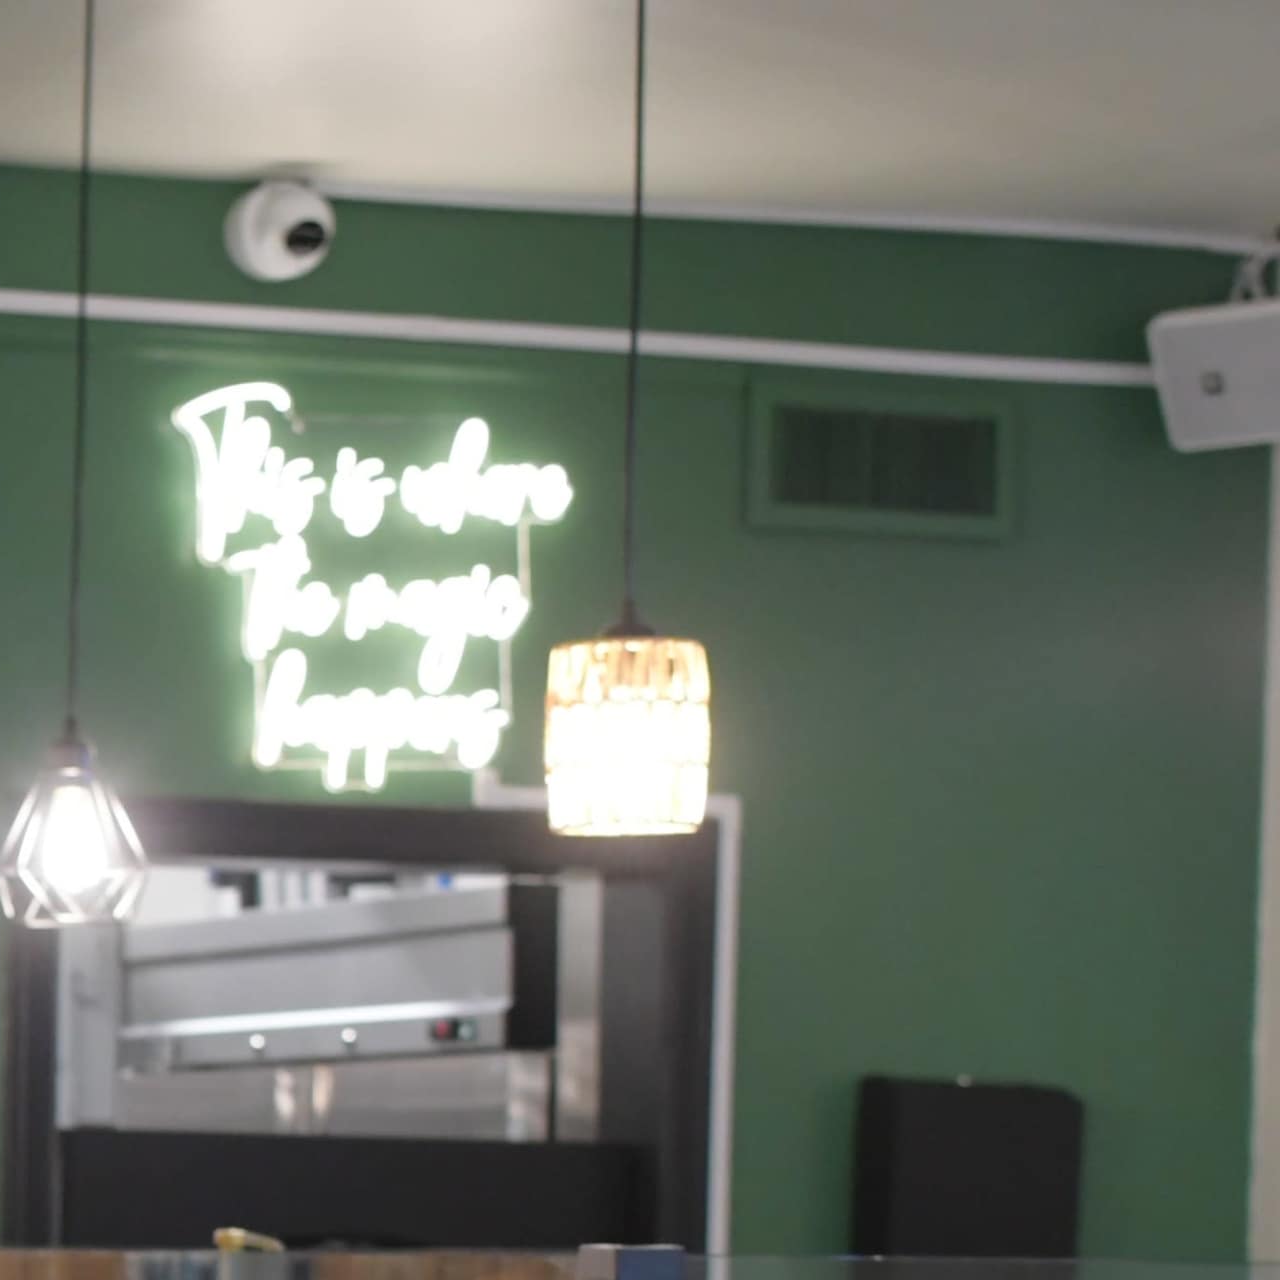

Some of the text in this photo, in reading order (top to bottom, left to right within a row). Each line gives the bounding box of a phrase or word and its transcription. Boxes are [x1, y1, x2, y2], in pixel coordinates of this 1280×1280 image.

[173, 381, 572, 562] This is where
[344, 563, 530, 694] magic
[255, 648, 509, 791] happens
